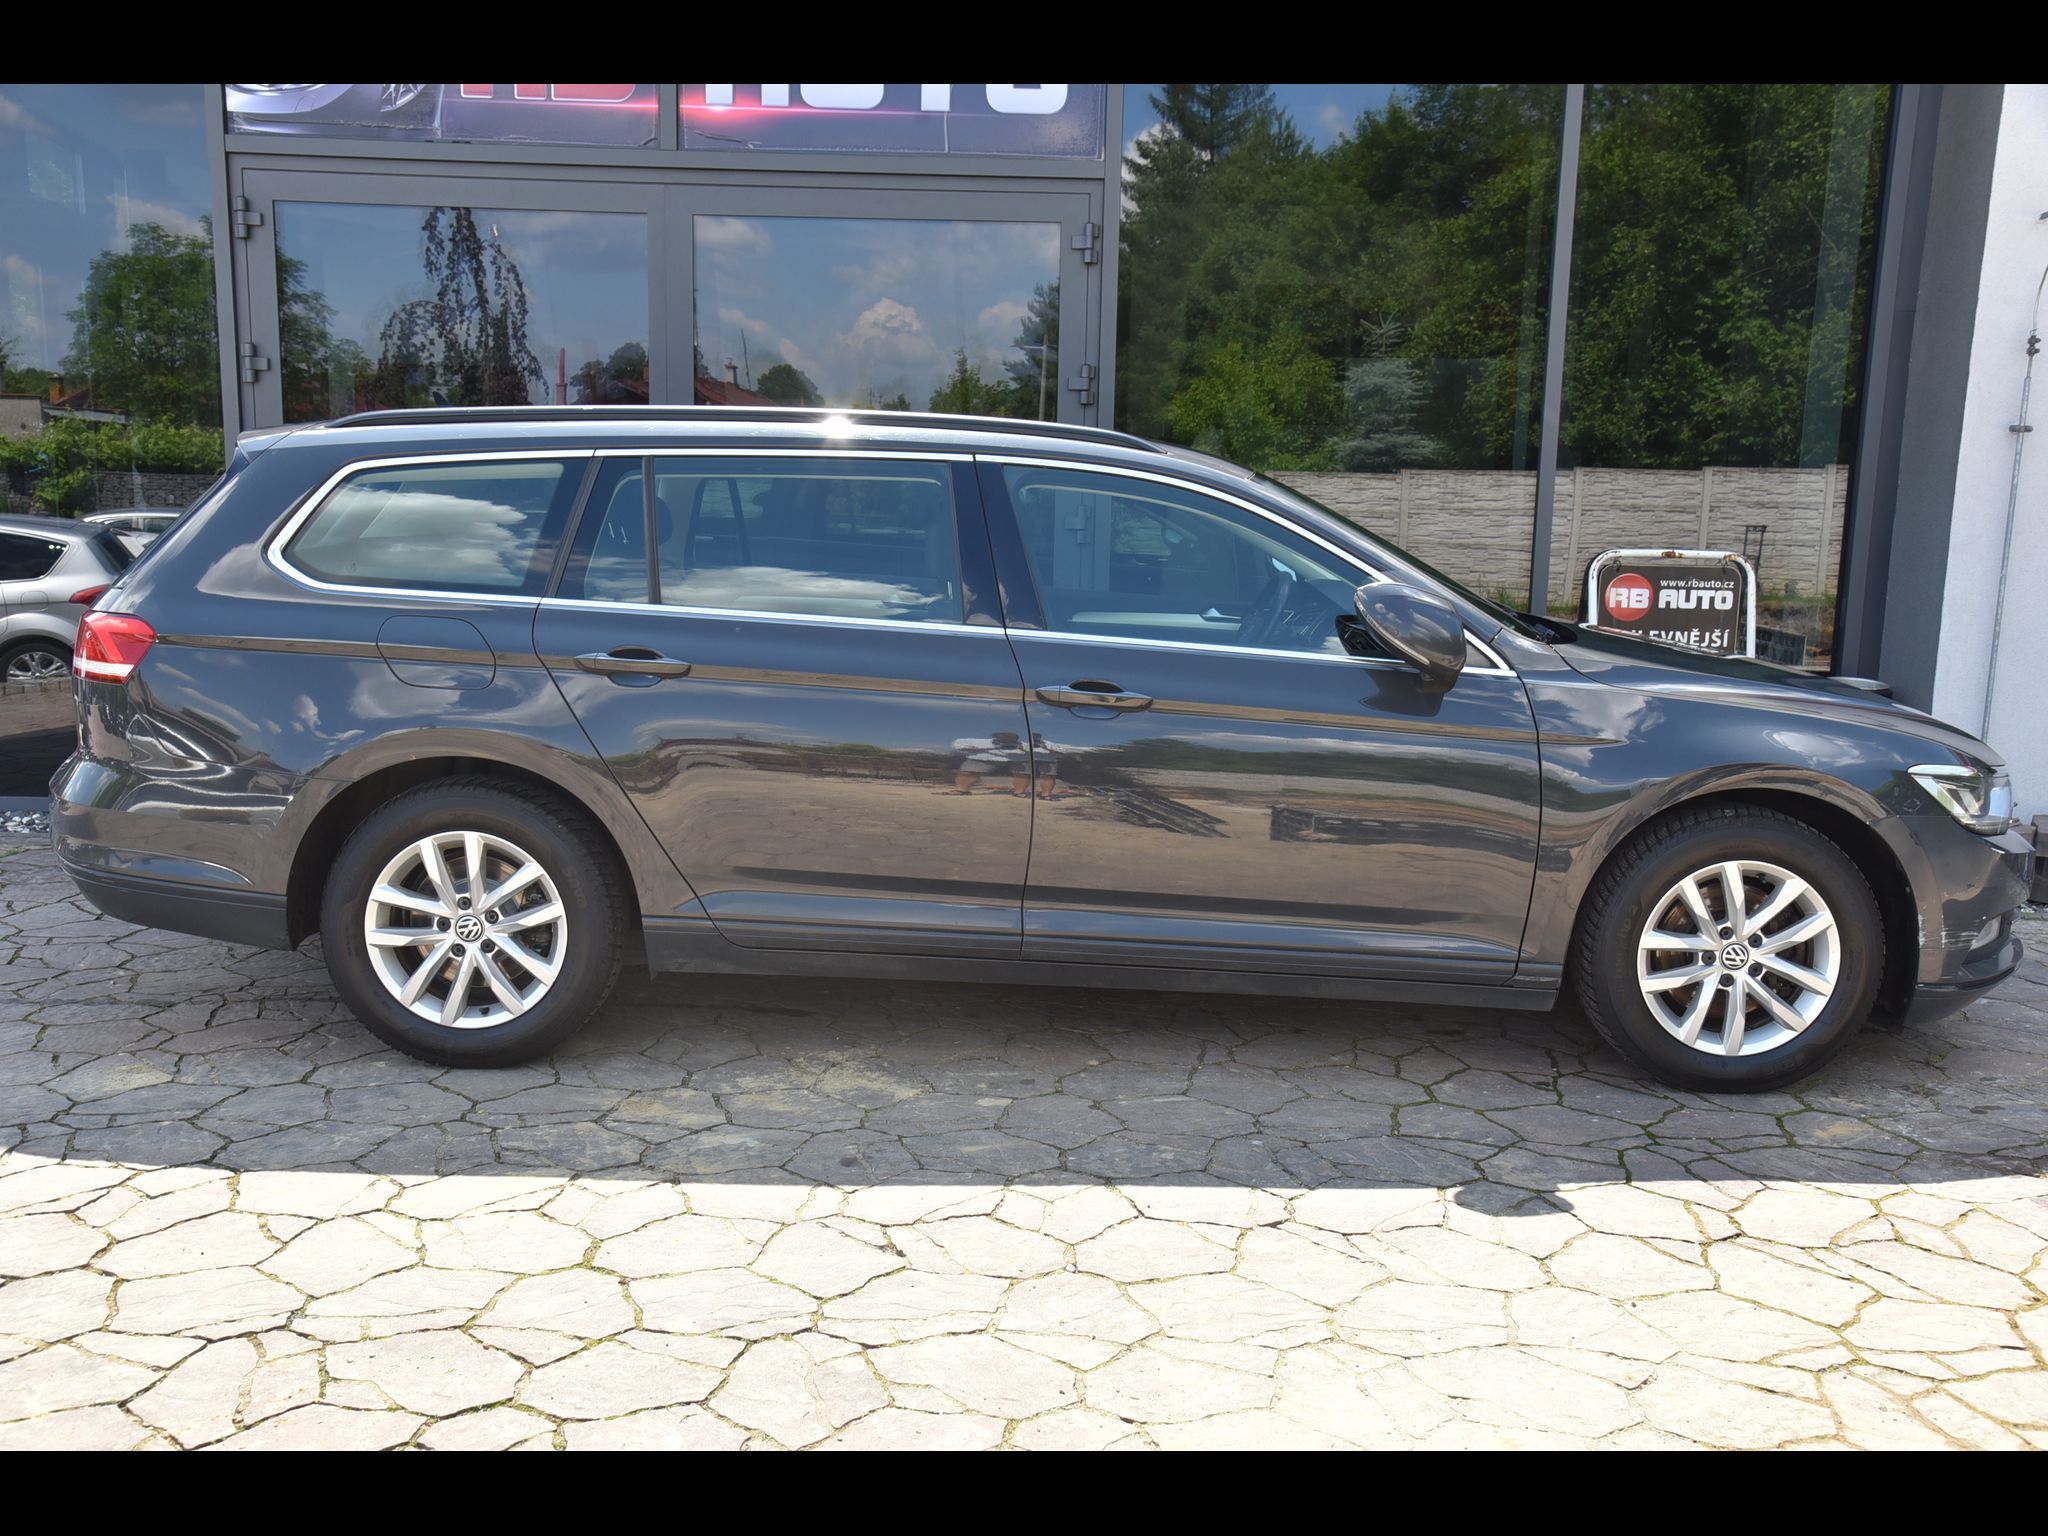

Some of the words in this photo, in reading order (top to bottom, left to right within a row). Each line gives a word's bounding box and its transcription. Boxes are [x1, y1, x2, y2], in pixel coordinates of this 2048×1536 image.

[1660, 578, 1735, 589] www.rbauto.cz
[1609, 587, 1650, 609] RB
[1658, 588, 1734, 611] AUTO
